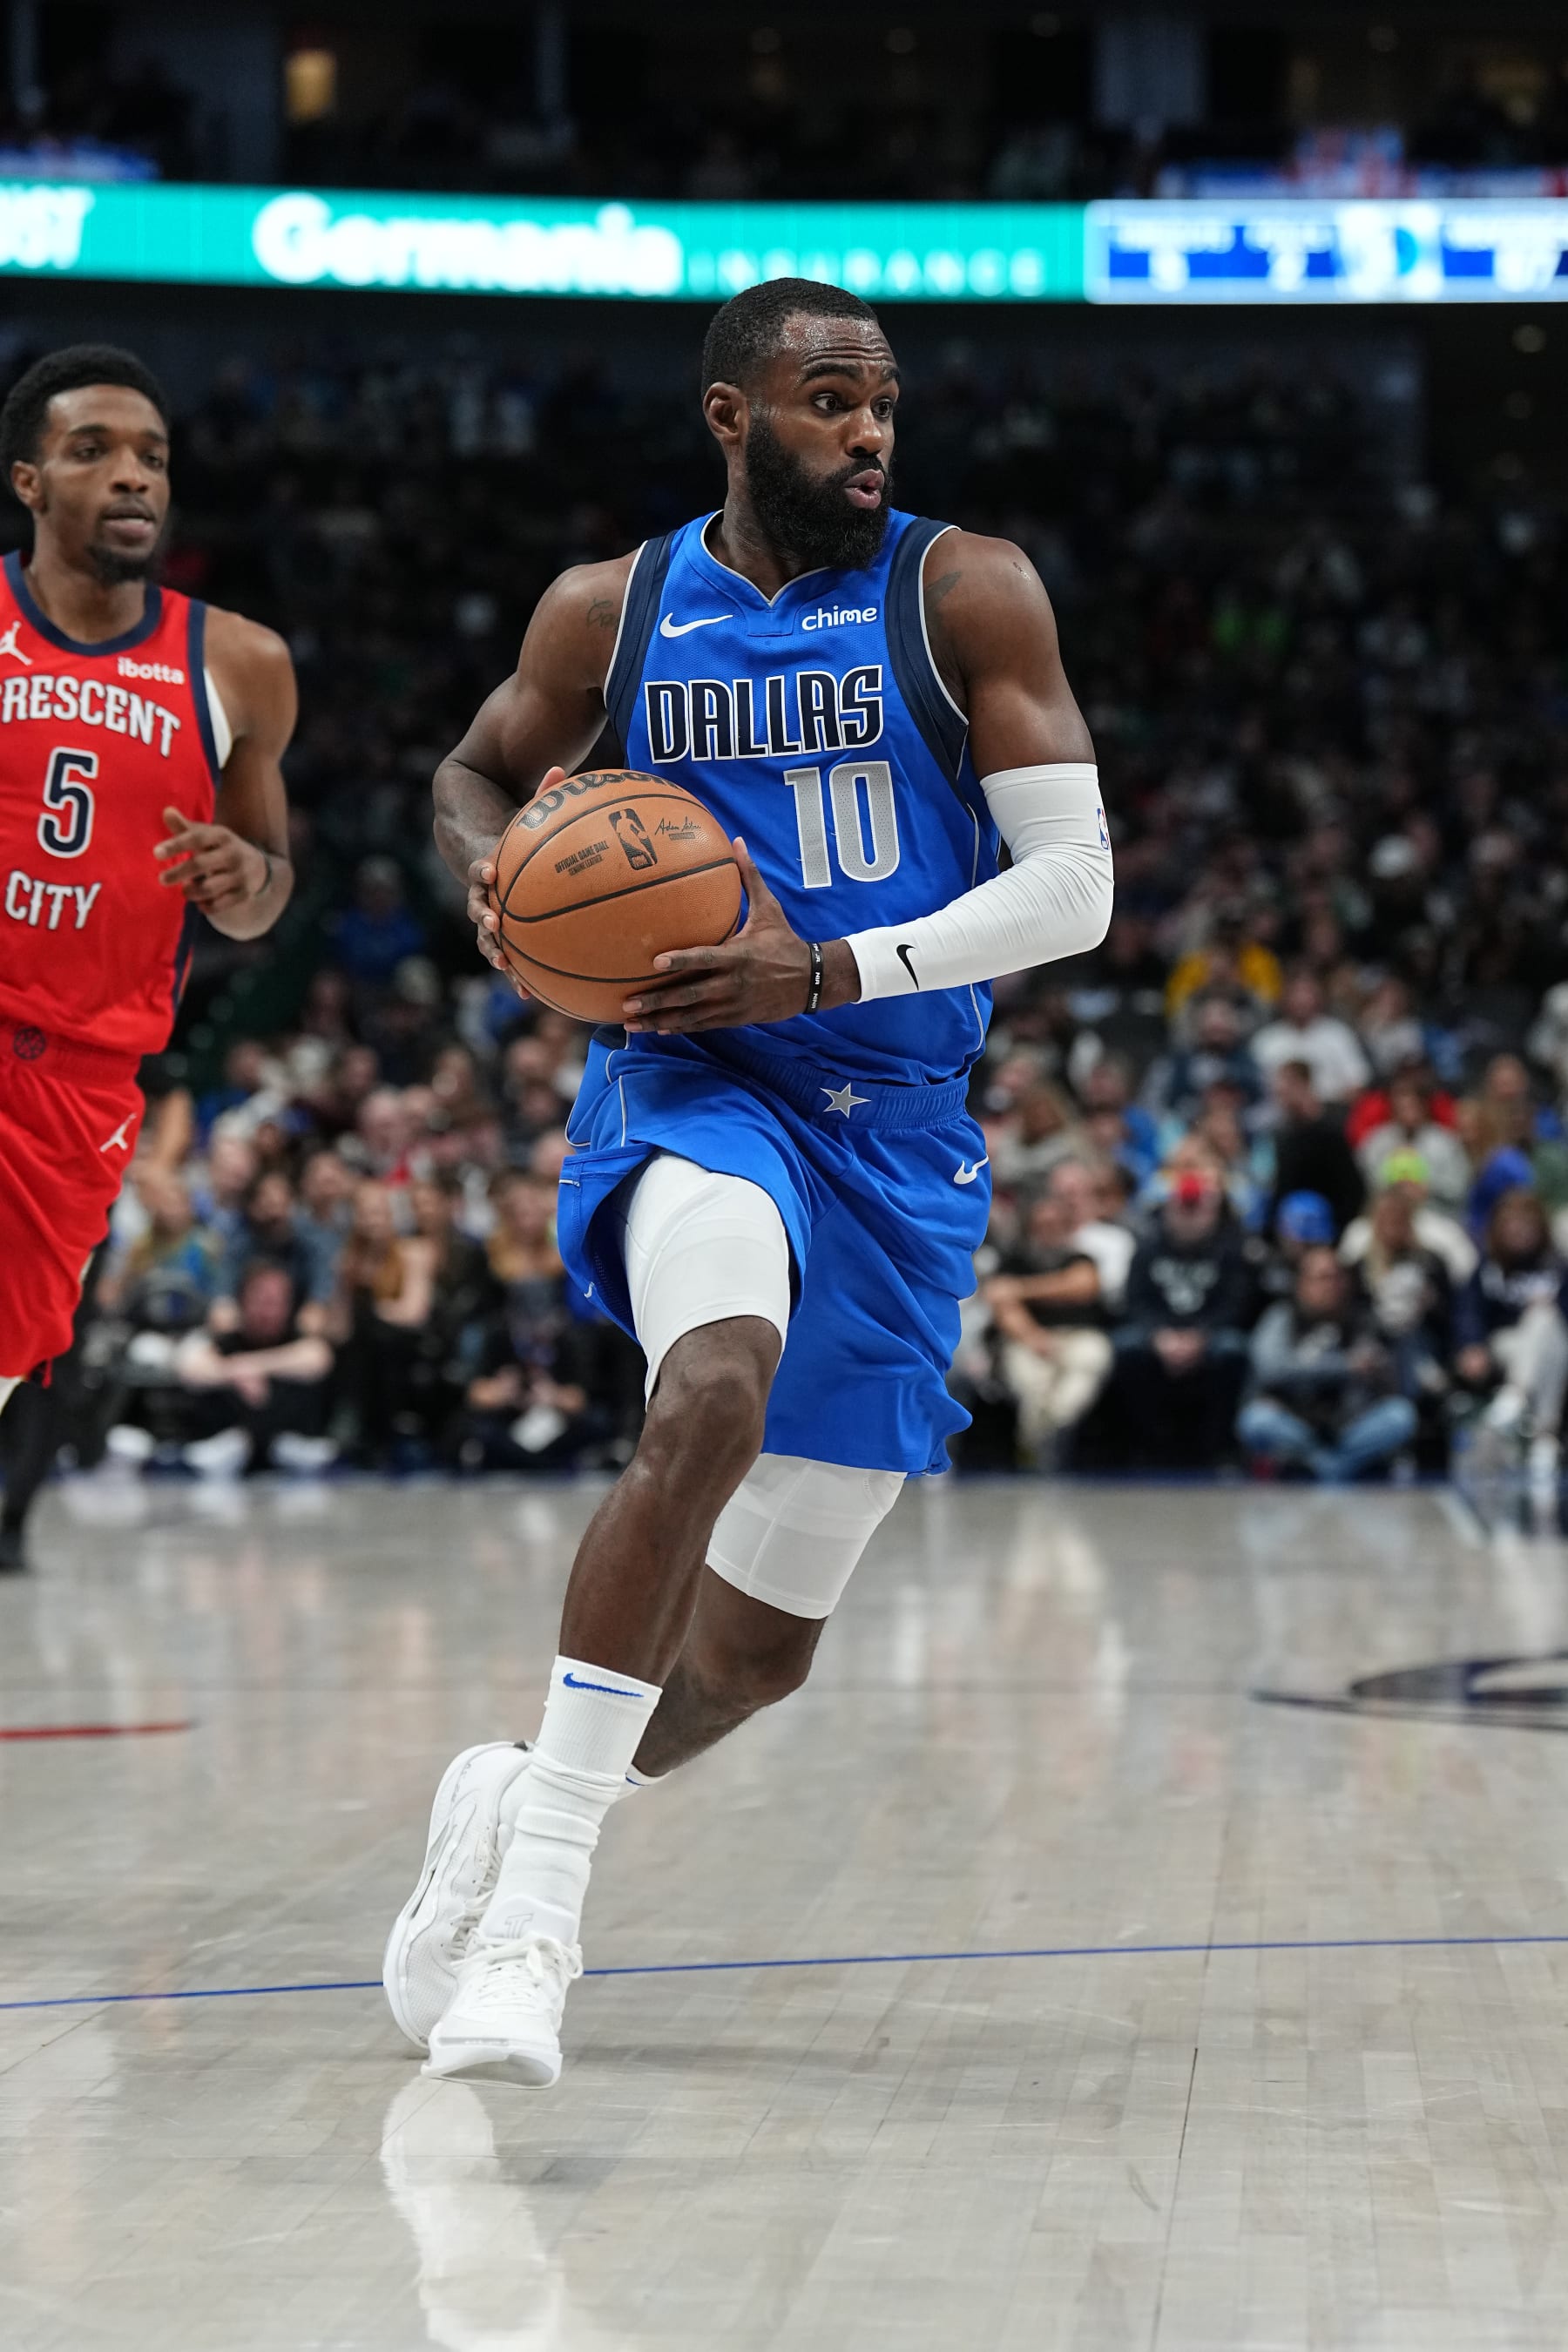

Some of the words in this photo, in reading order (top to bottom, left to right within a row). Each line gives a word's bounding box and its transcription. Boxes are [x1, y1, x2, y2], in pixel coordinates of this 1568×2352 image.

[801, 605, 878, 632] chime
[118, 656, 185, 685] ibotta
[0, 674, 181, 758] RESCENT
[644, 665, 885, 764] DALLAS
[37, 747, 98, 859] 5
[783, 760, 902, 889] 10
[5, 869, 102, 930] CITY
